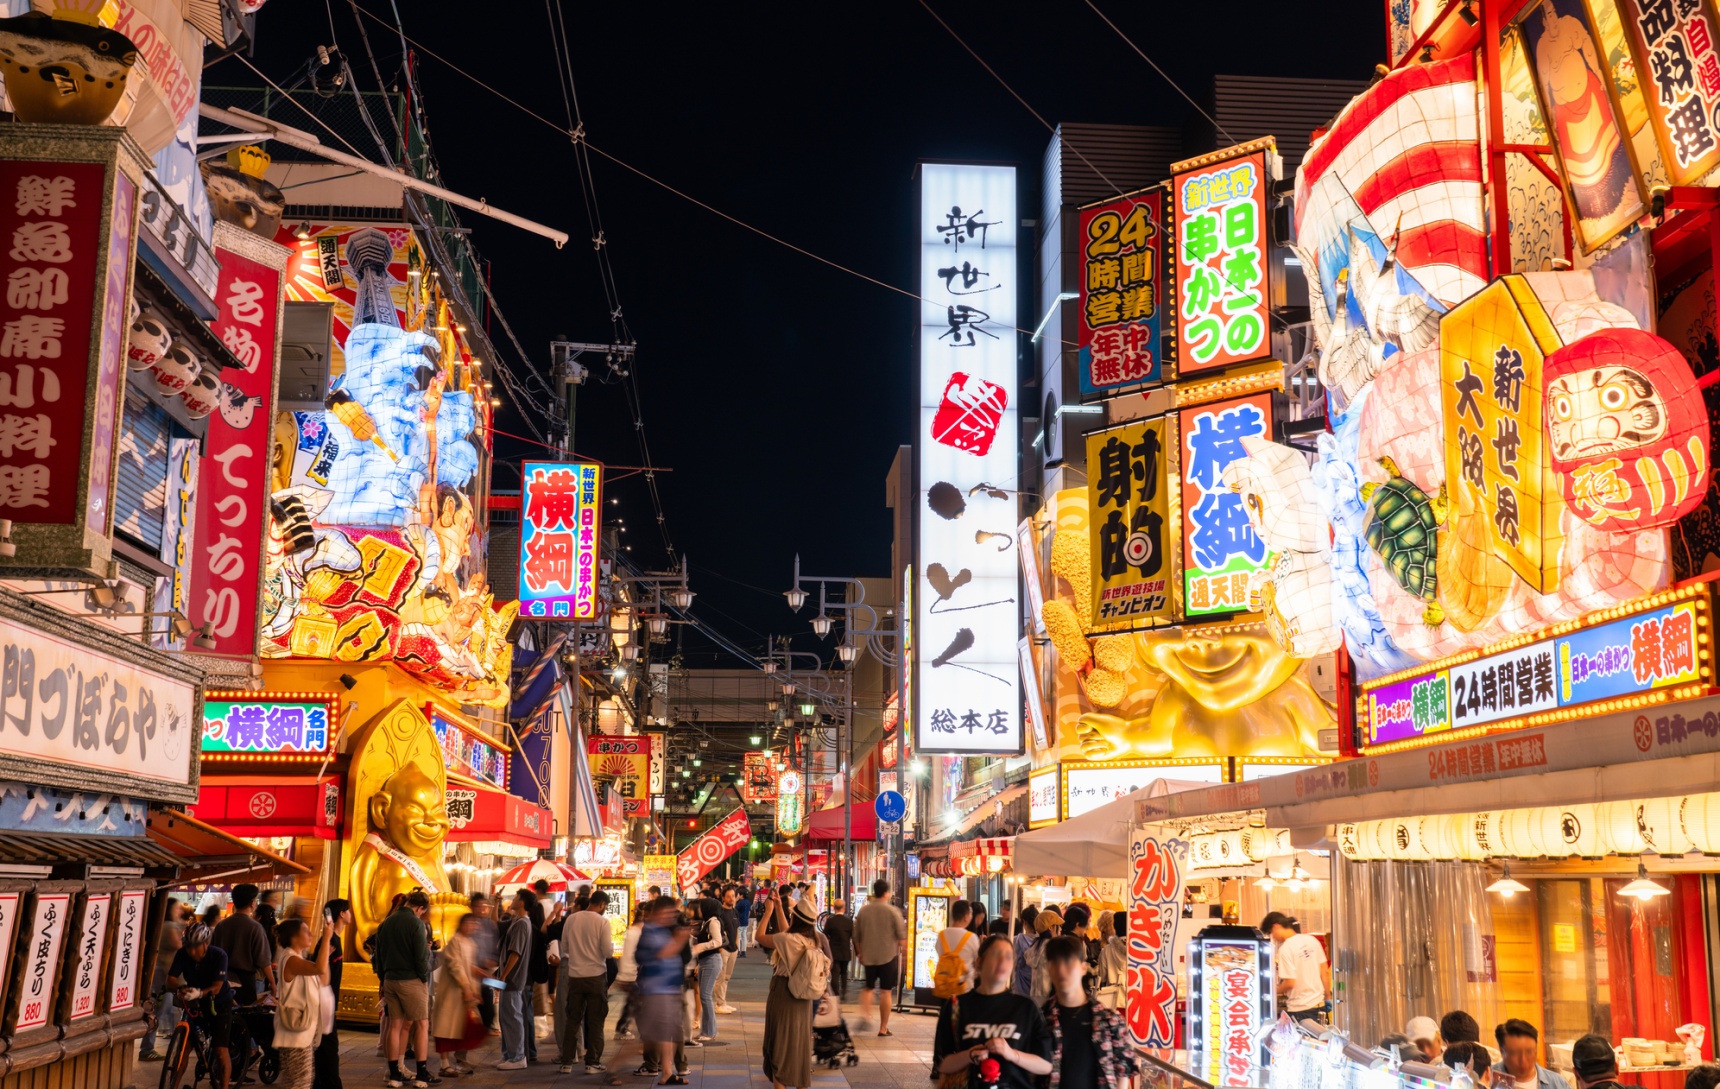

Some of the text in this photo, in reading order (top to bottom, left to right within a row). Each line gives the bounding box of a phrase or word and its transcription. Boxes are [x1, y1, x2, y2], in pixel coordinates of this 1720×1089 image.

[1184, 165, 1254, 211] 新世界
[1088, 205, 1154, 257] 24
[320, 239, 341, 286] 通天閣
[936, 205, 1003, 347] 新世界
[1089, 250, 1154, 290] 時間
[1225, 203, 1260, 350] 日本一の
[1088, 285, 1154, 326] 営業
[1185, 214, 1221, 359] 串かつ
[1092, 325, 1149, 356] 年中
[1092, 353, 1151, 384] 無休
[203, 277, 264, 638] 名物 てっちり
[1491, 345, 1525, 548] 新世界
[582, 468, 596, 505] 新世界
[1097, 429, 1164, 582] 射的
[525, 469, 576, 592] 横綱
[577, 508, 594, 616] 日本一の串かつ
[530, 601, 569, 616] 名門
[1100, 595, 1167, 619] チャンピオン
[1101, 579, 1165, 601] 新世界遊技場
[1190, 572, 1249, 608] 通天閣
[1572, 645, 1630, 684] 日本一の串かつ
[1631, 610, 1694, 684] 横綱
[1411, 676, 1448, 731] 横綱
[1454, 651, 1555, 720] 24時間営業
[225, 706, 304, 749] 横綱
[305, 709, 326, 749] 名門
[930, 707, 1009, 735] 総本店
[598, 742, 638, 753] 串かつ
[1428, 738, 1545, 781] 24時間営業 年中無休
[445, 798, 473, 820] 綱
[31, 903, 57, 996] ふぐ皮ちり
[80, 904, 101, 989] ふぐ天ぷら
[119, 899, 137, 981] ふぐにぎり
[1127, 841, 1177, 1040] かき氷
[25, 1001, 41, 1021] 880
[75, 996, 90, 1012] 1,320
[116, 986, 129, 1003] 880
